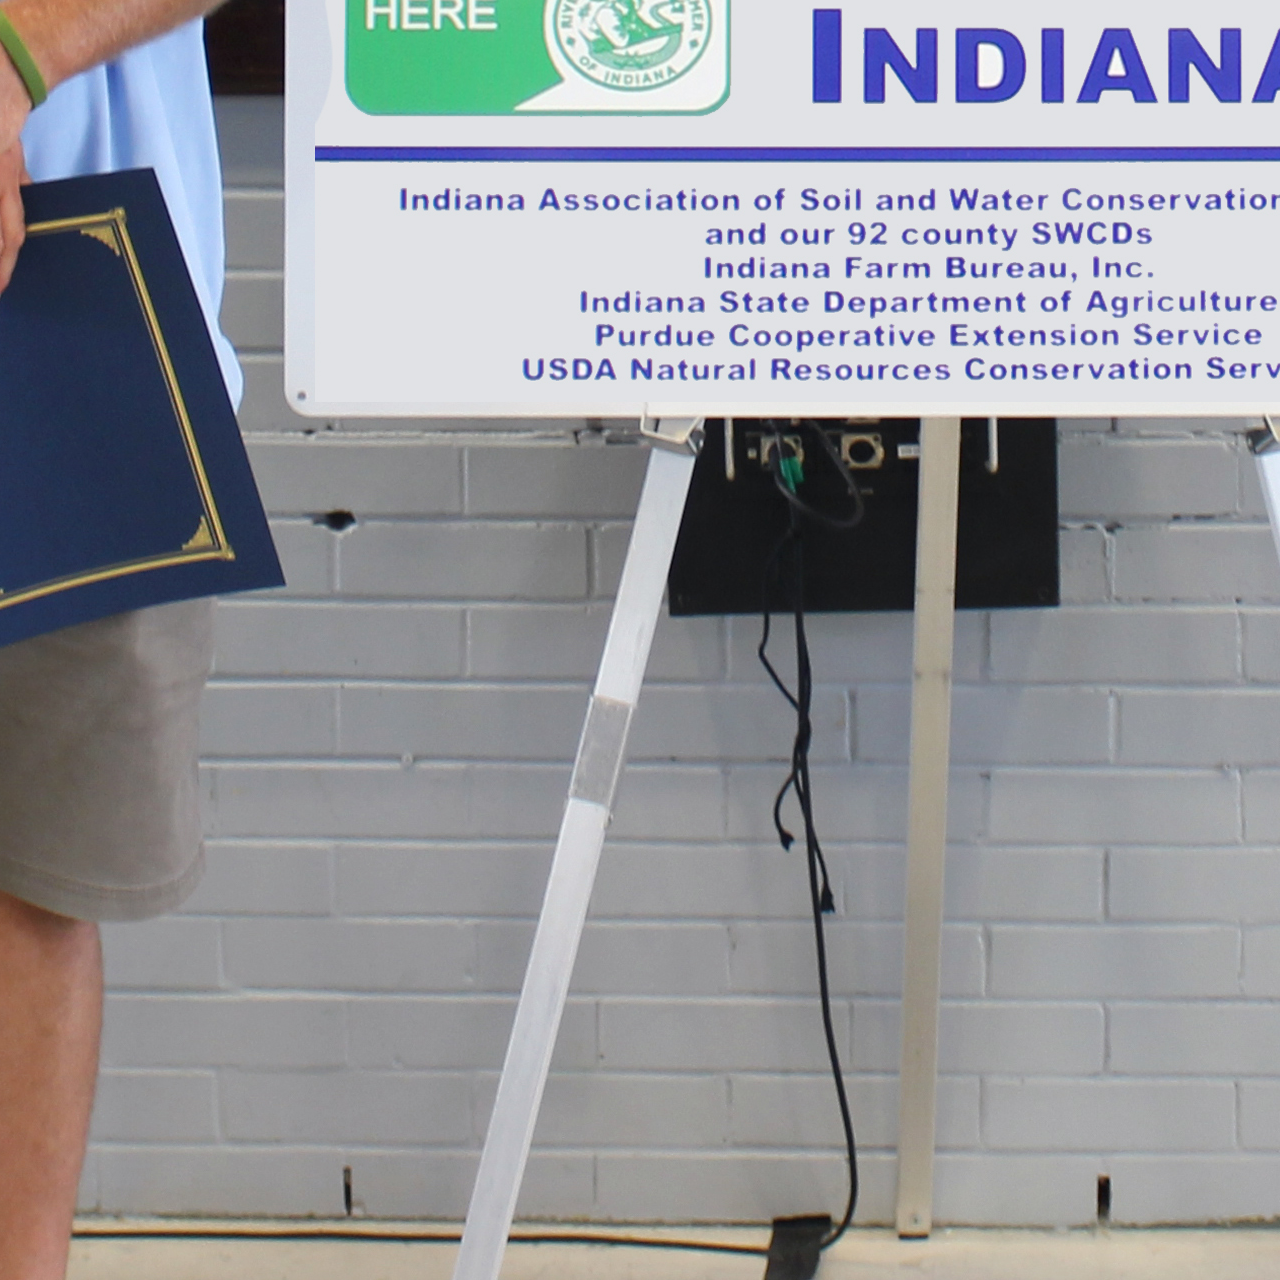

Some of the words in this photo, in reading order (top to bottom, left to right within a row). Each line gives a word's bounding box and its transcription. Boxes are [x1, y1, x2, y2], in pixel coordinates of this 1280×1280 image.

[579, 56, 599, 72] OF
[604, 66, 677, 85] INDIANA
[400, 188, 524, 211] Indiana
[538, 188, 739, 211] Association
[754, 188, 784, 211] of
[801, 188, 861, 211] Soil
[876, 188, 935, 211] and
[949, 188, 1048, 211] Water
[705, 223, 765, 245] and
[780, 229, 834, 245] our
[848, 222, 887, 245] 92
[901, 224, 1017, 251] county
[1032, 222, 1152, 245] SWCDs
[705, 257, 830, 279] Indiana
[845, 257, 930, 278] Farm
[946, 257, 1077, 283] Bureau,
[1093, 256, 1153, 278] Inc.
[580, 291, 704, 313] Indiana
[720, 291, 809, 313] State
[824, 291, 1025, 319] Department
[1040, 291, 1071, 312] of
[1086, 291, 1277, 318] Agriculture
[595, 324, 714, 346] Purdue
[729, 324, 935, 352] Cooperative
[950, 324, 1119, 346] Extension
[1134, 323, 1262, 345] Service
[522, 358, 616, 381] USDA
[631, 359, 755, 381] Natural
[771, 359, 950, 381] Resources
[965, 358, 1192, 380] Conservation
